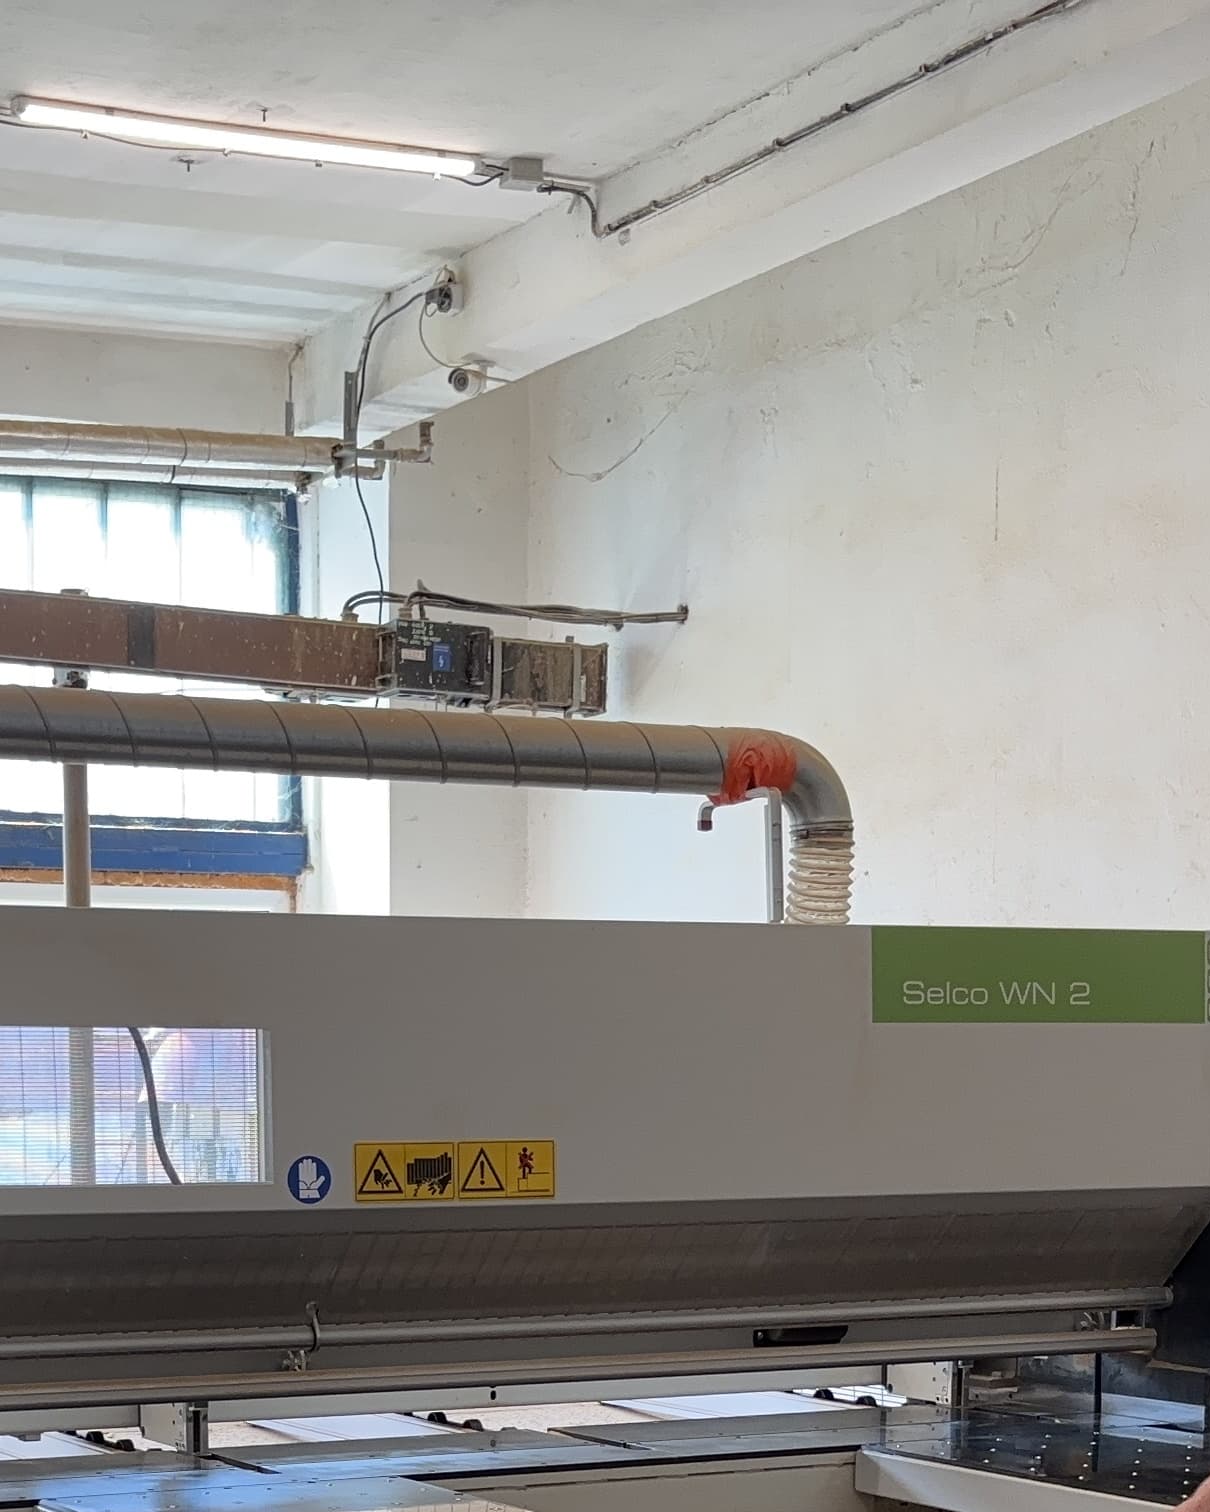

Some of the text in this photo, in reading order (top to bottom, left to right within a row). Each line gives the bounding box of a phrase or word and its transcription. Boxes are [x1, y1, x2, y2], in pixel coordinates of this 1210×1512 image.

[903, 981, 1091, 1005] Selco WN 2
